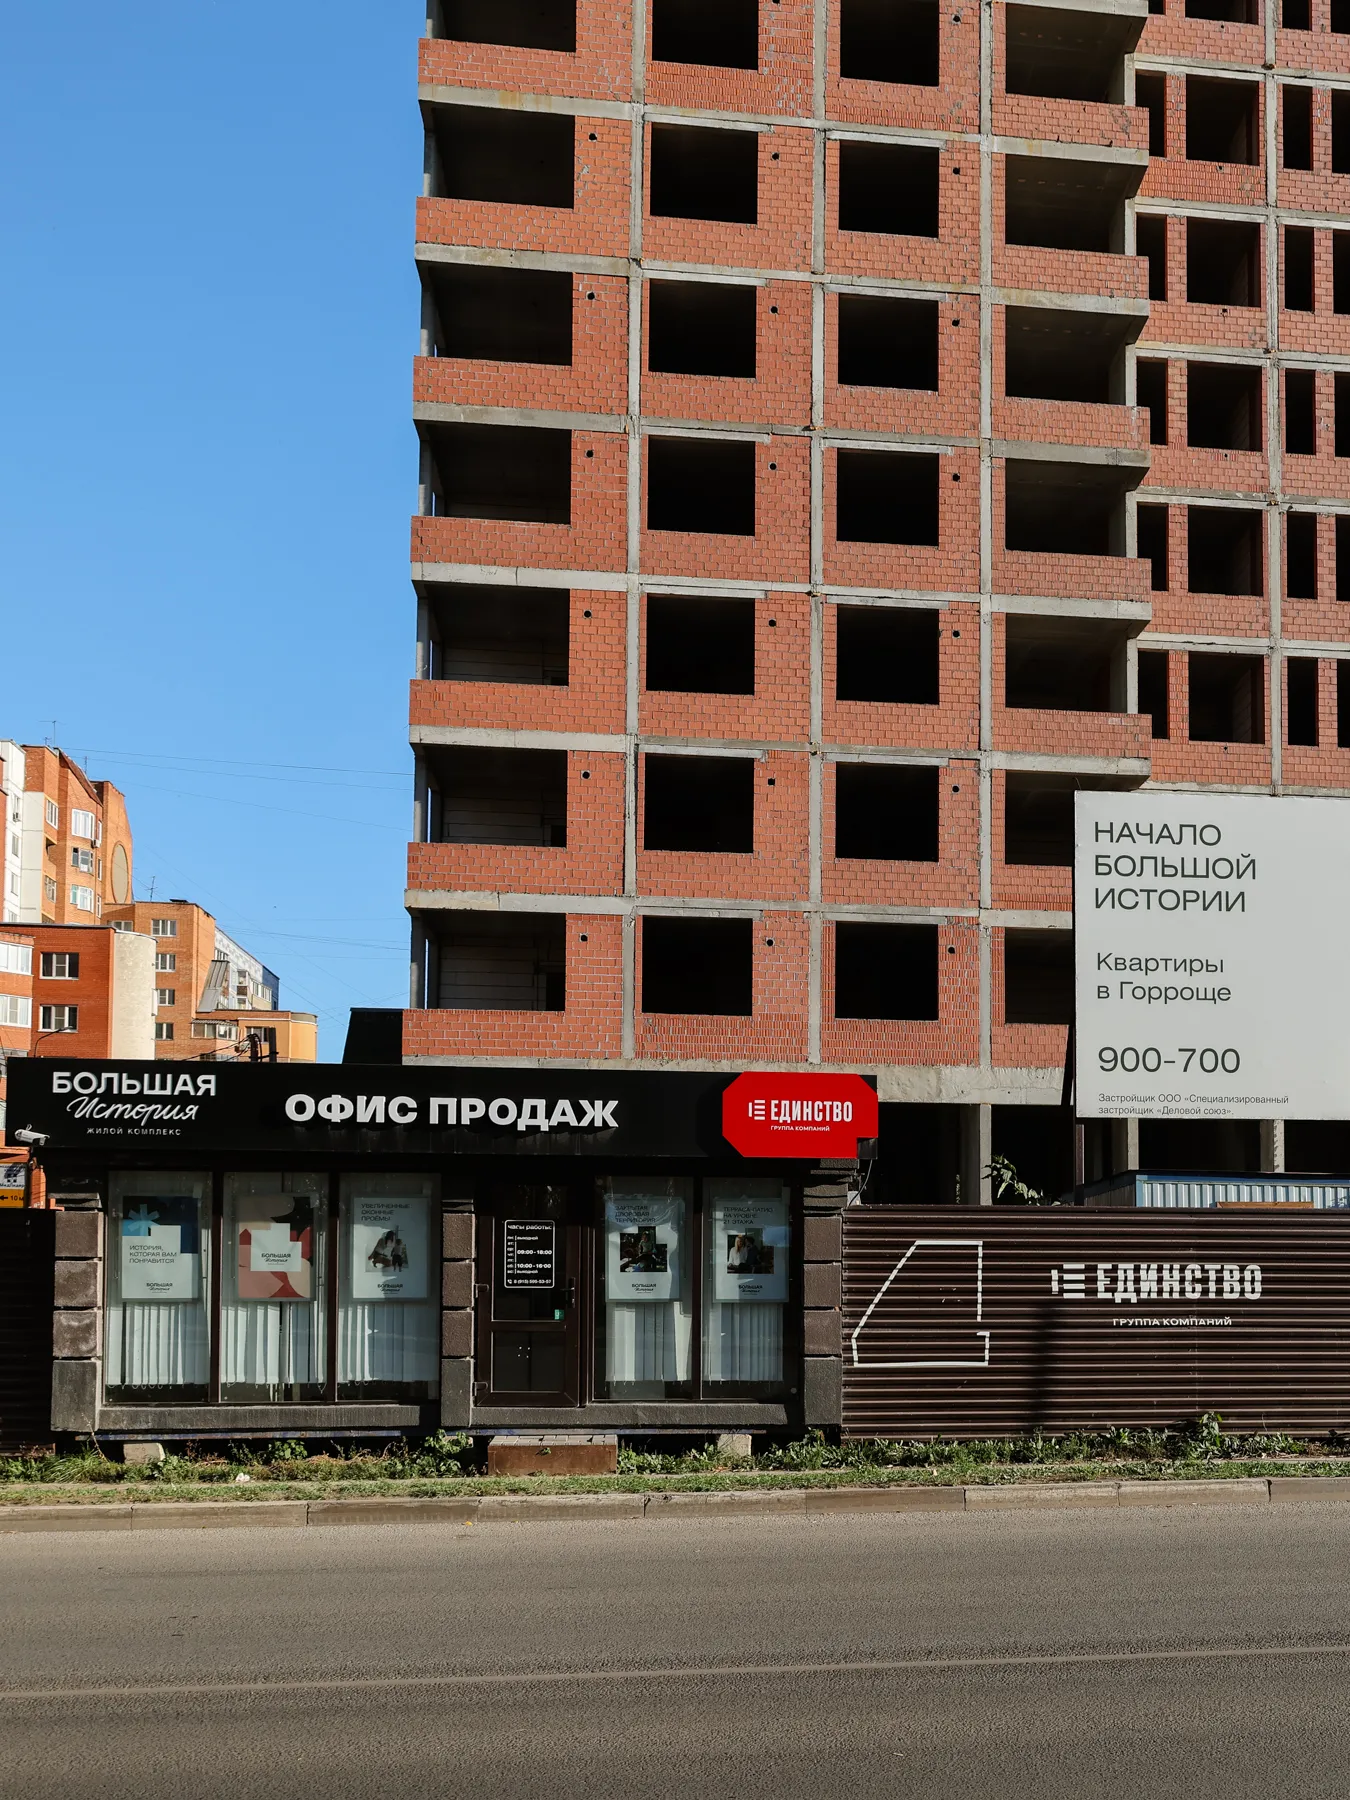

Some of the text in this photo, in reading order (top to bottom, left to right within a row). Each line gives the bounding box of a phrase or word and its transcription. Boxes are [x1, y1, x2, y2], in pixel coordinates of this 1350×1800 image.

[1094, 821, 1222, 847] НАЧАЛО
[1094, 853, 1256, 880] БОЛЬШОЙ
[1094, 887, 1246, 913] ИСТОРИИ
[1096, 952, 1225, 977] Квартиры
[1097, 982, 1232, 1005] в Горроще
[52, 1071, 216, 1096] БОЛЬШАЯ
[66, 1096, 199, 1126] История
[771, 1099, 852, 1123] ЕДИНСТВО
[1098, 1093, 1289, 1105] Застройщик ООО «Специализированный
[1098, 1106, 1234, 1116] застройщик «Деловой союз».
[285, 1093, 619, 1131] ОФИС ПРОДАЖ
[87, 1127, 181, 1136] ЖИЛОЙ КОМПЛЕКС
[1097, 1263, 1262, 1303] ЕДИНСТВО
[1113, 1316, 1232, 1326] ГРУППА КОМПАНИЙ
